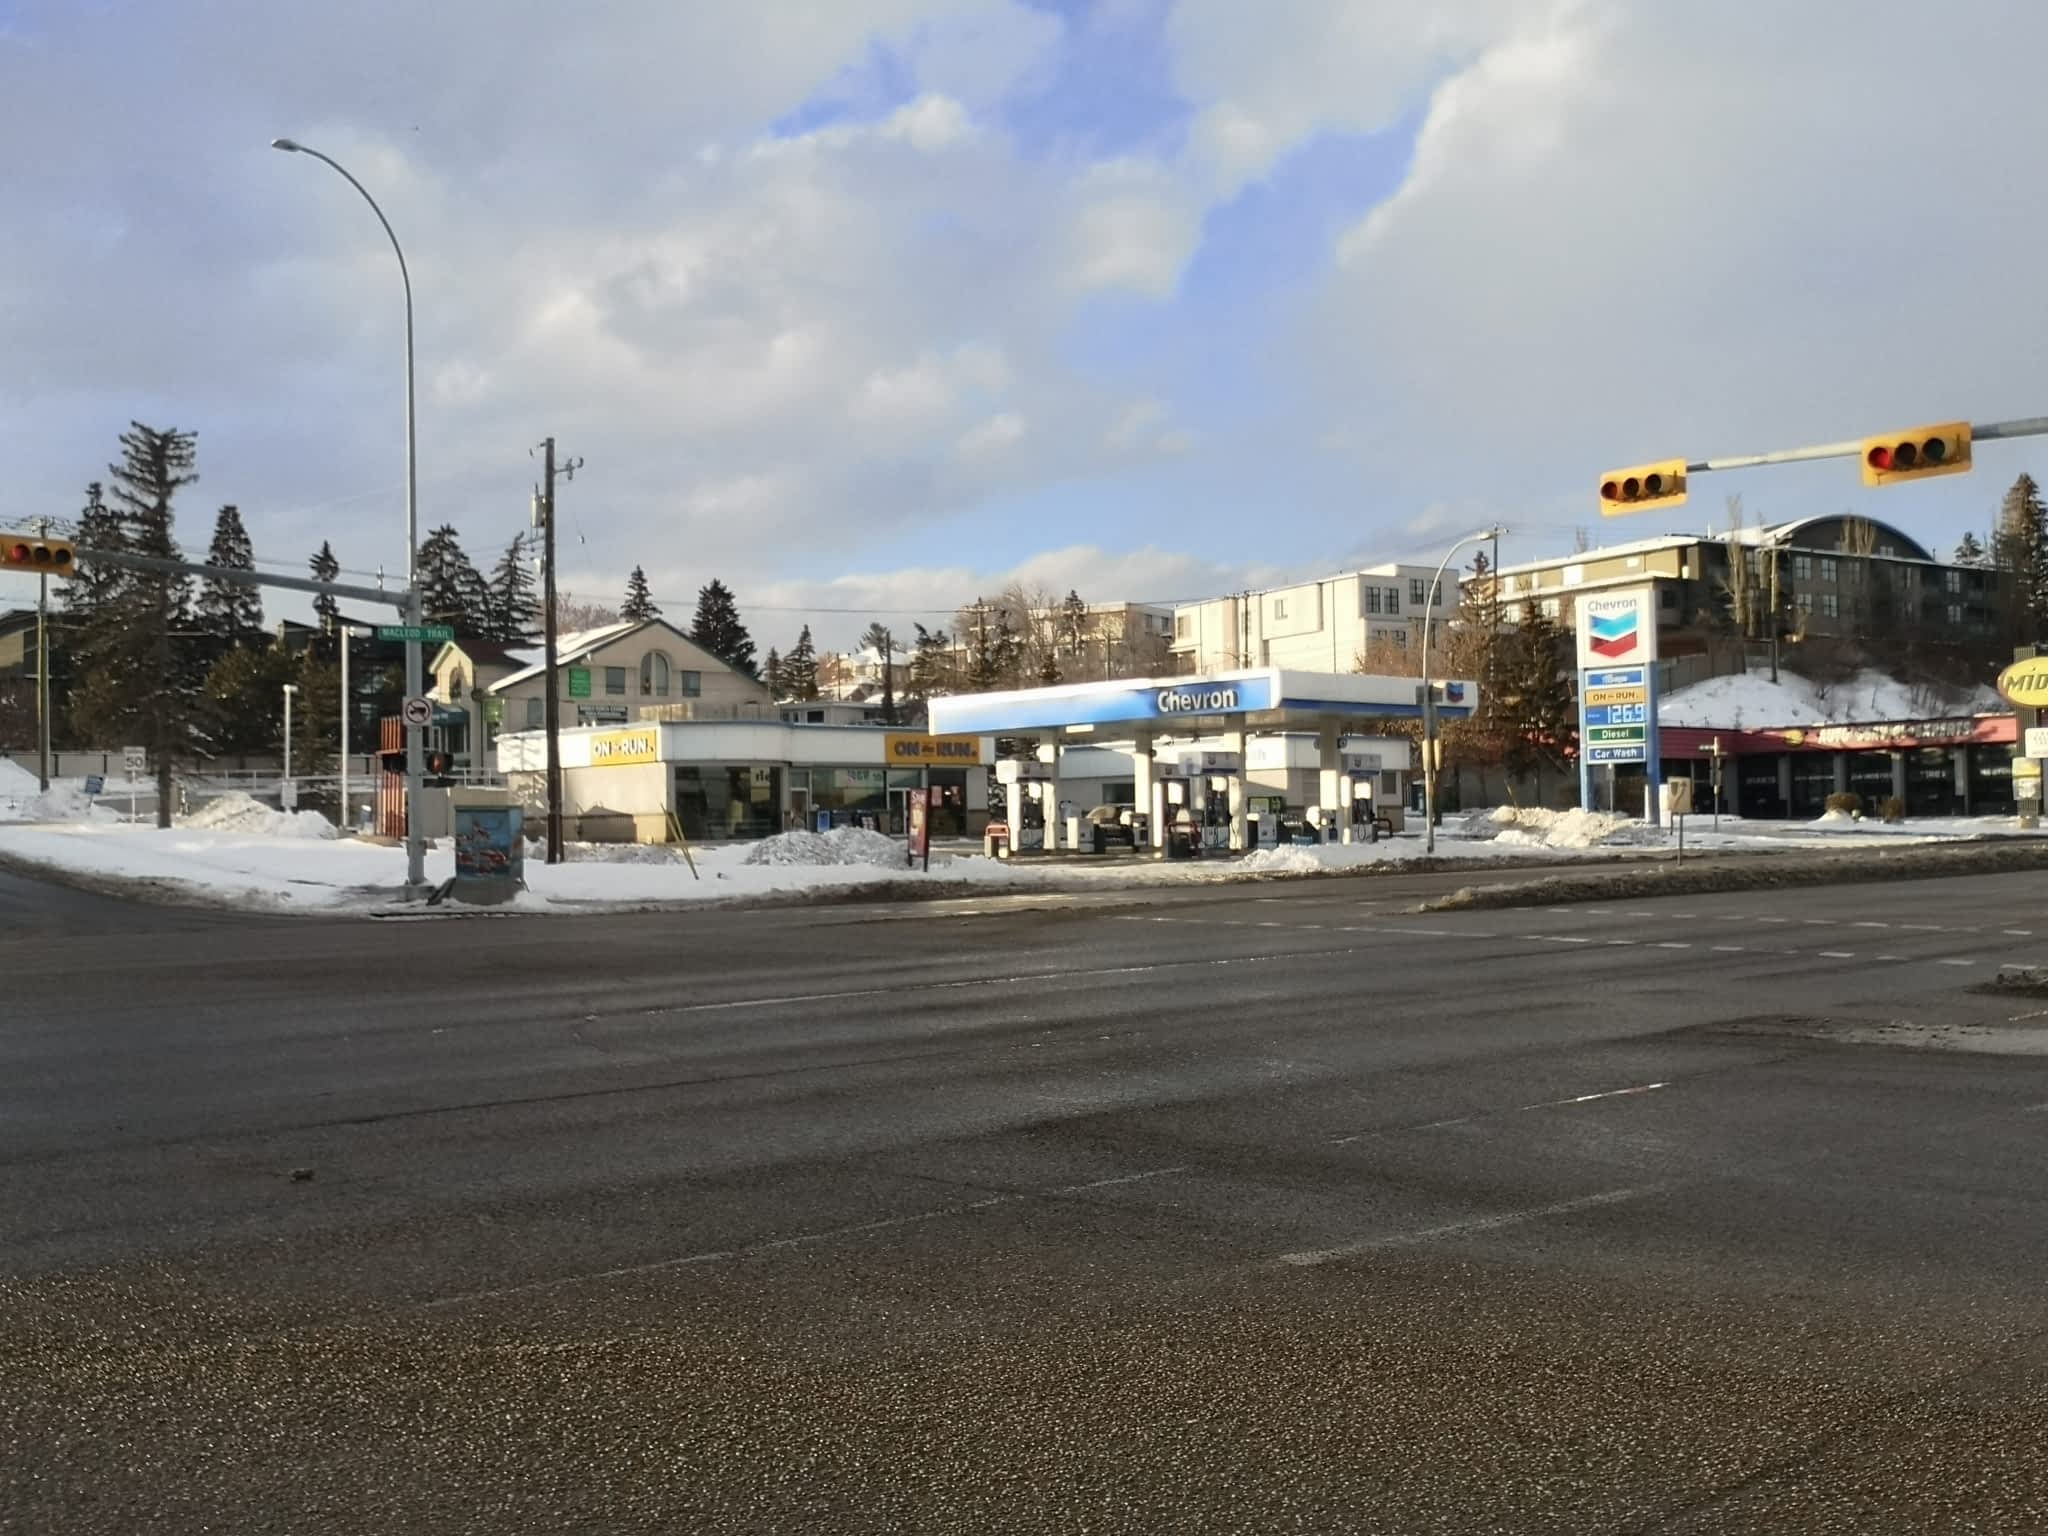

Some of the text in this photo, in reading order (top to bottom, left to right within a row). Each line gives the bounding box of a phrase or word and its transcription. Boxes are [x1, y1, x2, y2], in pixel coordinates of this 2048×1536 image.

[1587, 598, 1637, 612] Chevron
[1157, 688, 1235, 712] Chevron
[1616, 691, 1635, 700] RUN
[1601, 729, 1629, 739] Diesel
[594, 741, 612, 757] ON
[622, 738, 648, 754] RUN
[895, 742, 919, 757] ON
[936, 742, 971, 757] RUN
[1594, 748, 1637, 758] Car Wash
[126, 756, 143, 769] 50
